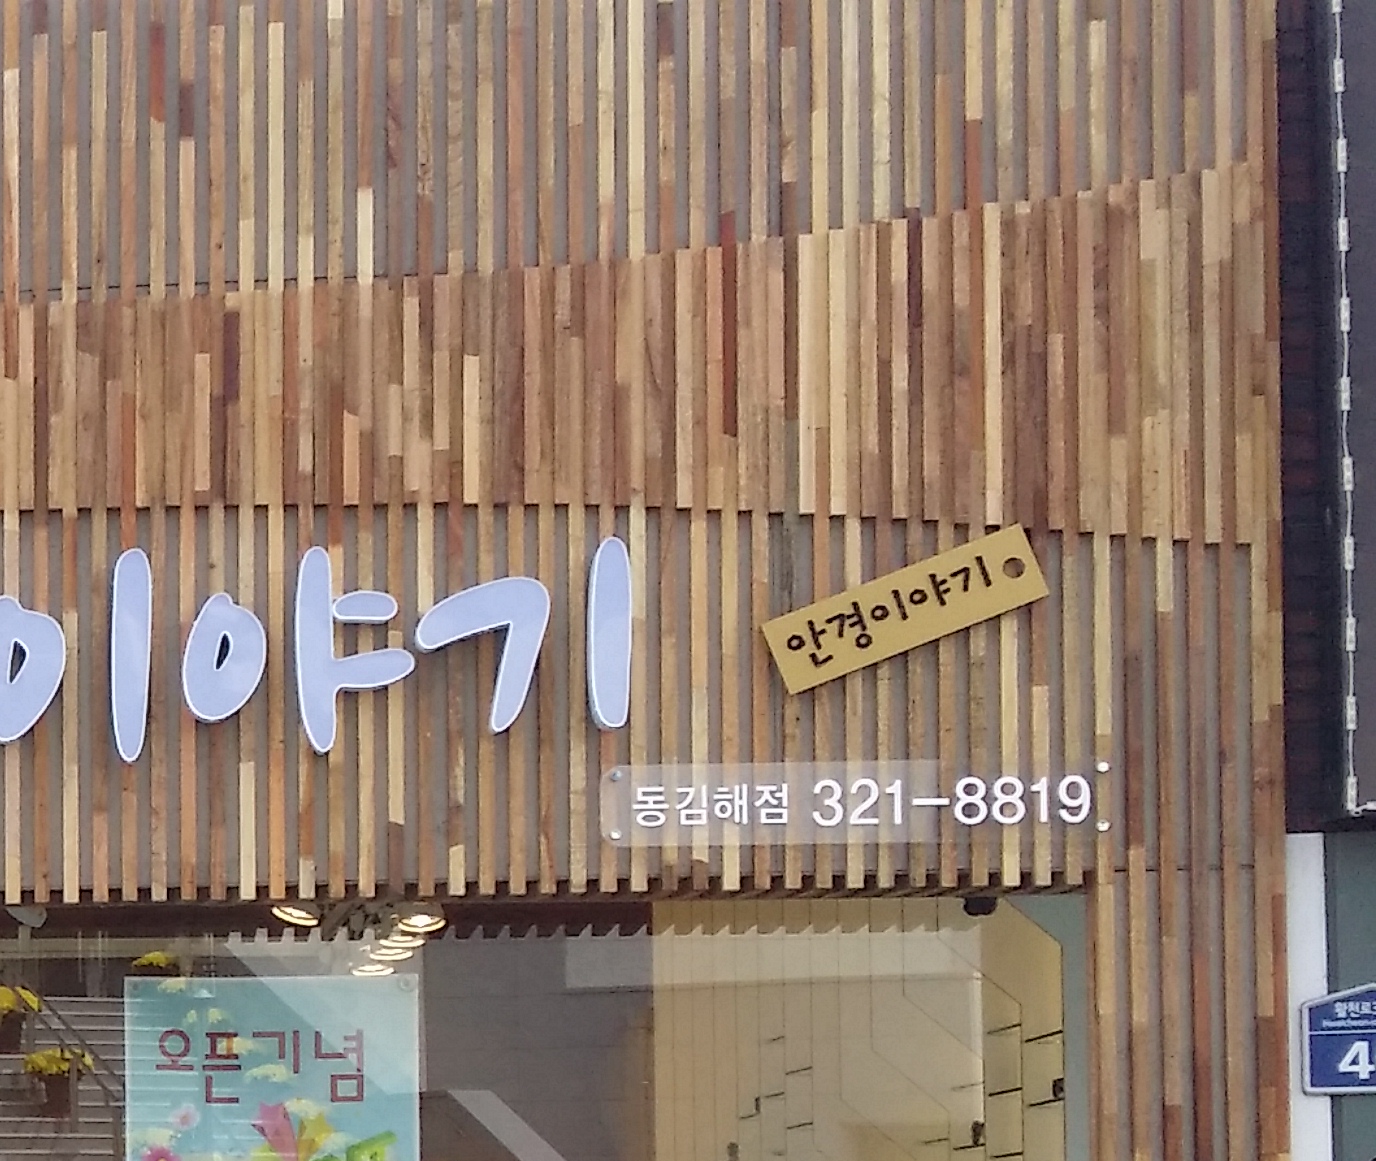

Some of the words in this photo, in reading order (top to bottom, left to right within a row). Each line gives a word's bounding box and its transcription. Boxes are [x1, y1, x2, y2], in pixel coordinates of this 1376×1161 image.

[785, 555, 992, 668] 안경이야기
[631, 783, 789, 828] 동김해점
[811, 774, 1092, 828] 321-8819
[155, 1028, 365, 1104] 오픈기념
